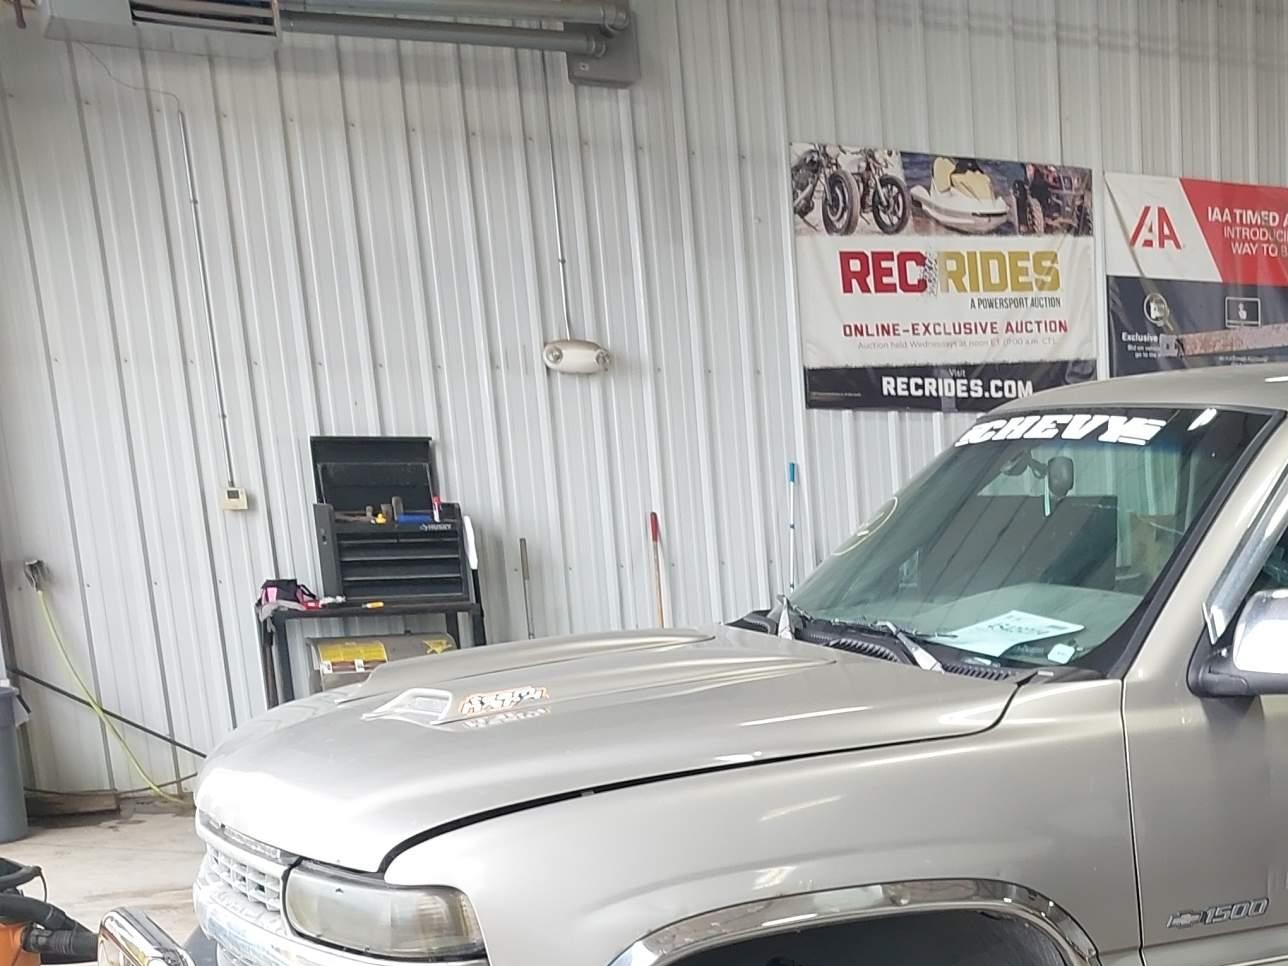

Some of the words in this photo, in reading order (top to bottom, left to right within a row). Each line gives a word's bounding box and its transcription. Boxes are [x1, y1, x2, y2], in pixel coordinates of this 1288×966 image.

[1208, 206, 1232, 223] IAA
[1233, 209, 1279, 227] TIMED
[1232, 244, 1258, 256] WAY
[1262, 244, 1278, 257] TO
[839, 250, 929, 294] REC
[940, 250, 1061, 293] RIDES
[970, 297, 976, 309] A
[978, 297, 1028, 309] POWERSPORT
[1030, 296, 1061, 308] AUCTION
[843, 321, 999, 338] ONLINE-EXCLUSIVE
[1005, 320, 1068, 335] AUCTION
[1121, 331, 1159, 343] Exclusive
[949, 368, 966, 378] Visit
[881, 376, 1034, 399] RECRIDES.COM
[1204, 897, 1270, 925] 1500
